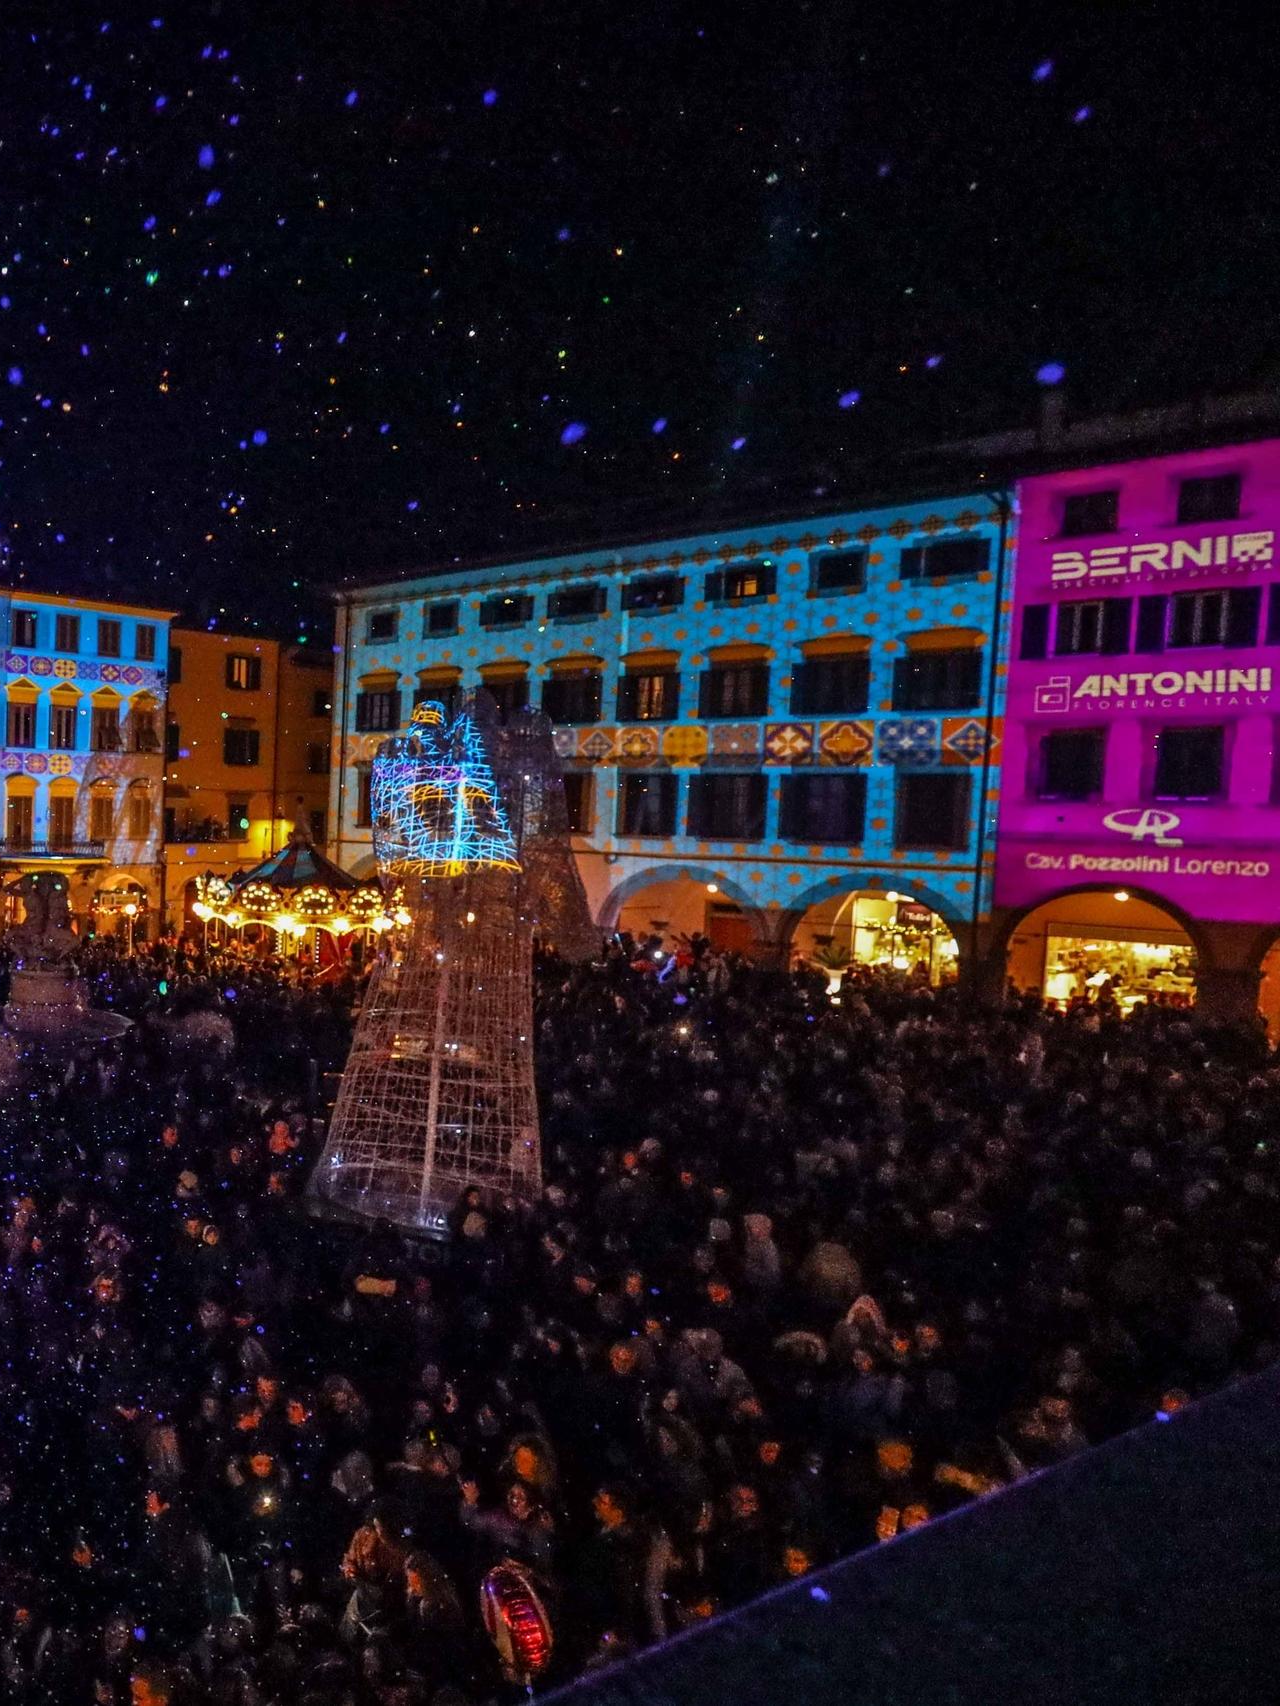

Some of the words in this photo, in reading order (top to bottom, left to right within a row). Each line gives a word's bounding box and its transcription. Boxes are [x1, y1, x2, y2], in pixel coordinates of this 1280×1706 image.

[1052, 535, 1228, 581] BERNI
[1073, 668, 1272, 698] ANTONINI
[1074, 698, 1186, 710] FLORENCE
[1204, 695, 1270, 706] ITALY
[1025, 852, 1066, 870] Cav.
[1070, 854, 1169, 872] Pozzolini
[1174, 857, 1270, 877] Lorenzo
